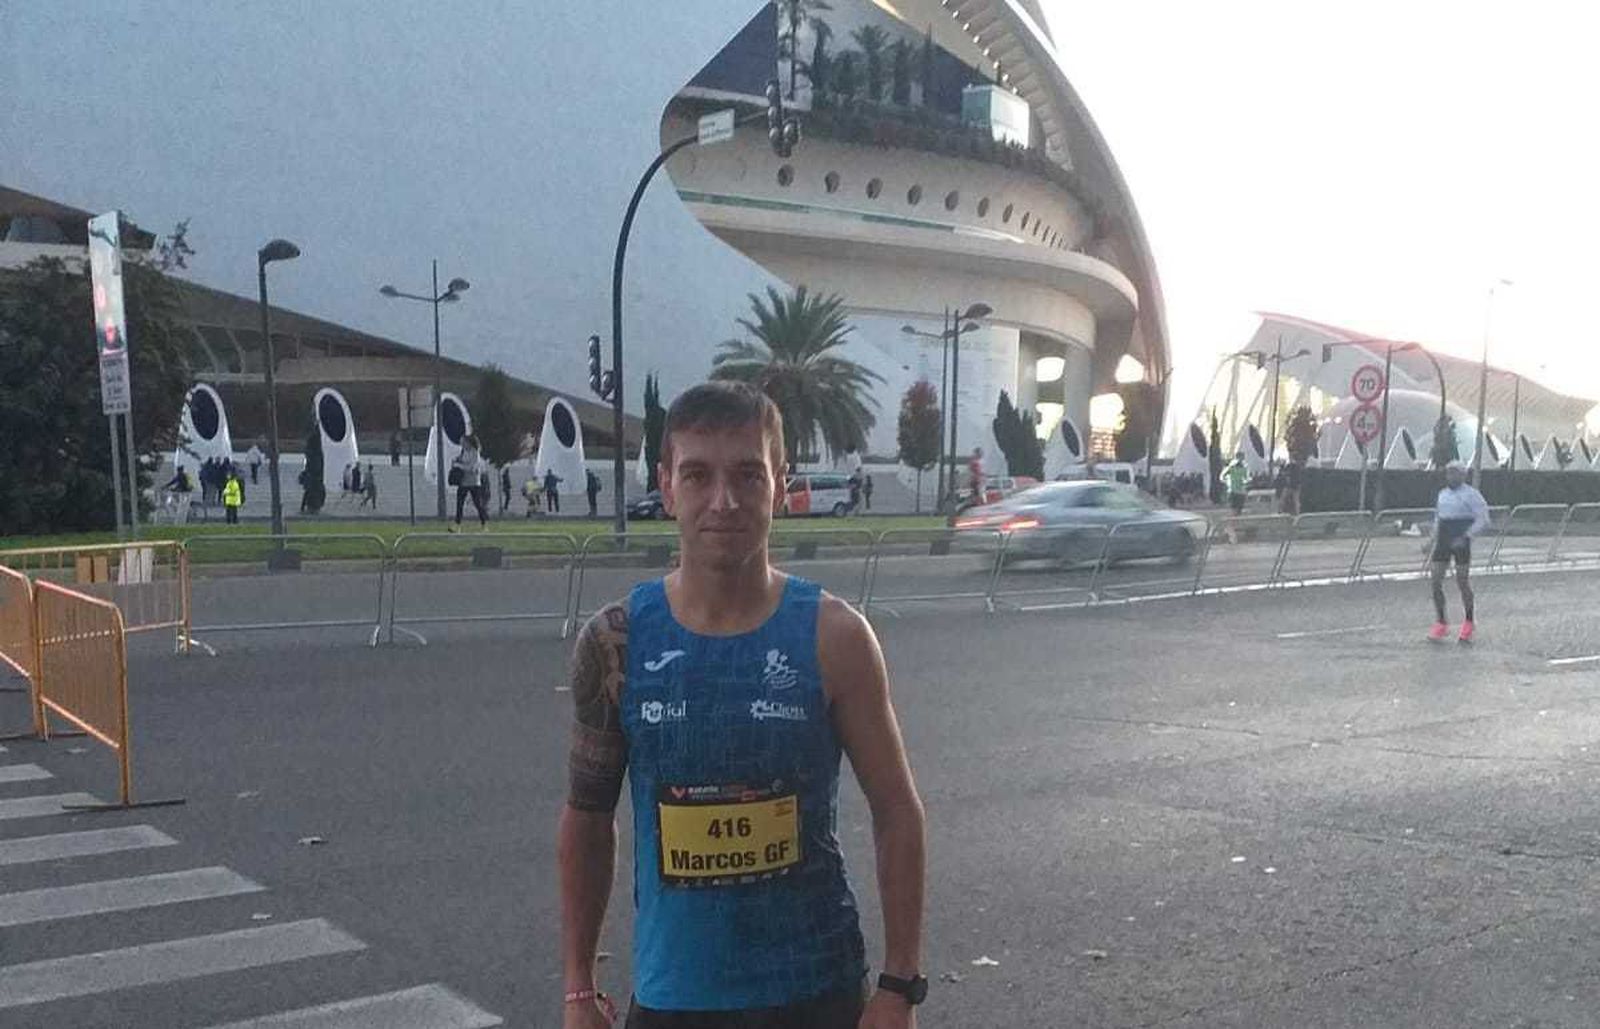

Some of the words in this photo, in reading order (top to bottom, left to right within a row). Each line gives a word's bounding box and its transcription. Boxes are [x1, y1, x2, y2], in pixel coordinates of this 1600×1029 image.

[1359, 377, 1376, 391] 70
[707, 817, 752, 839] 416
[670, 848, 757, 871] Marcos
[764, 840, 790, 863] GF
